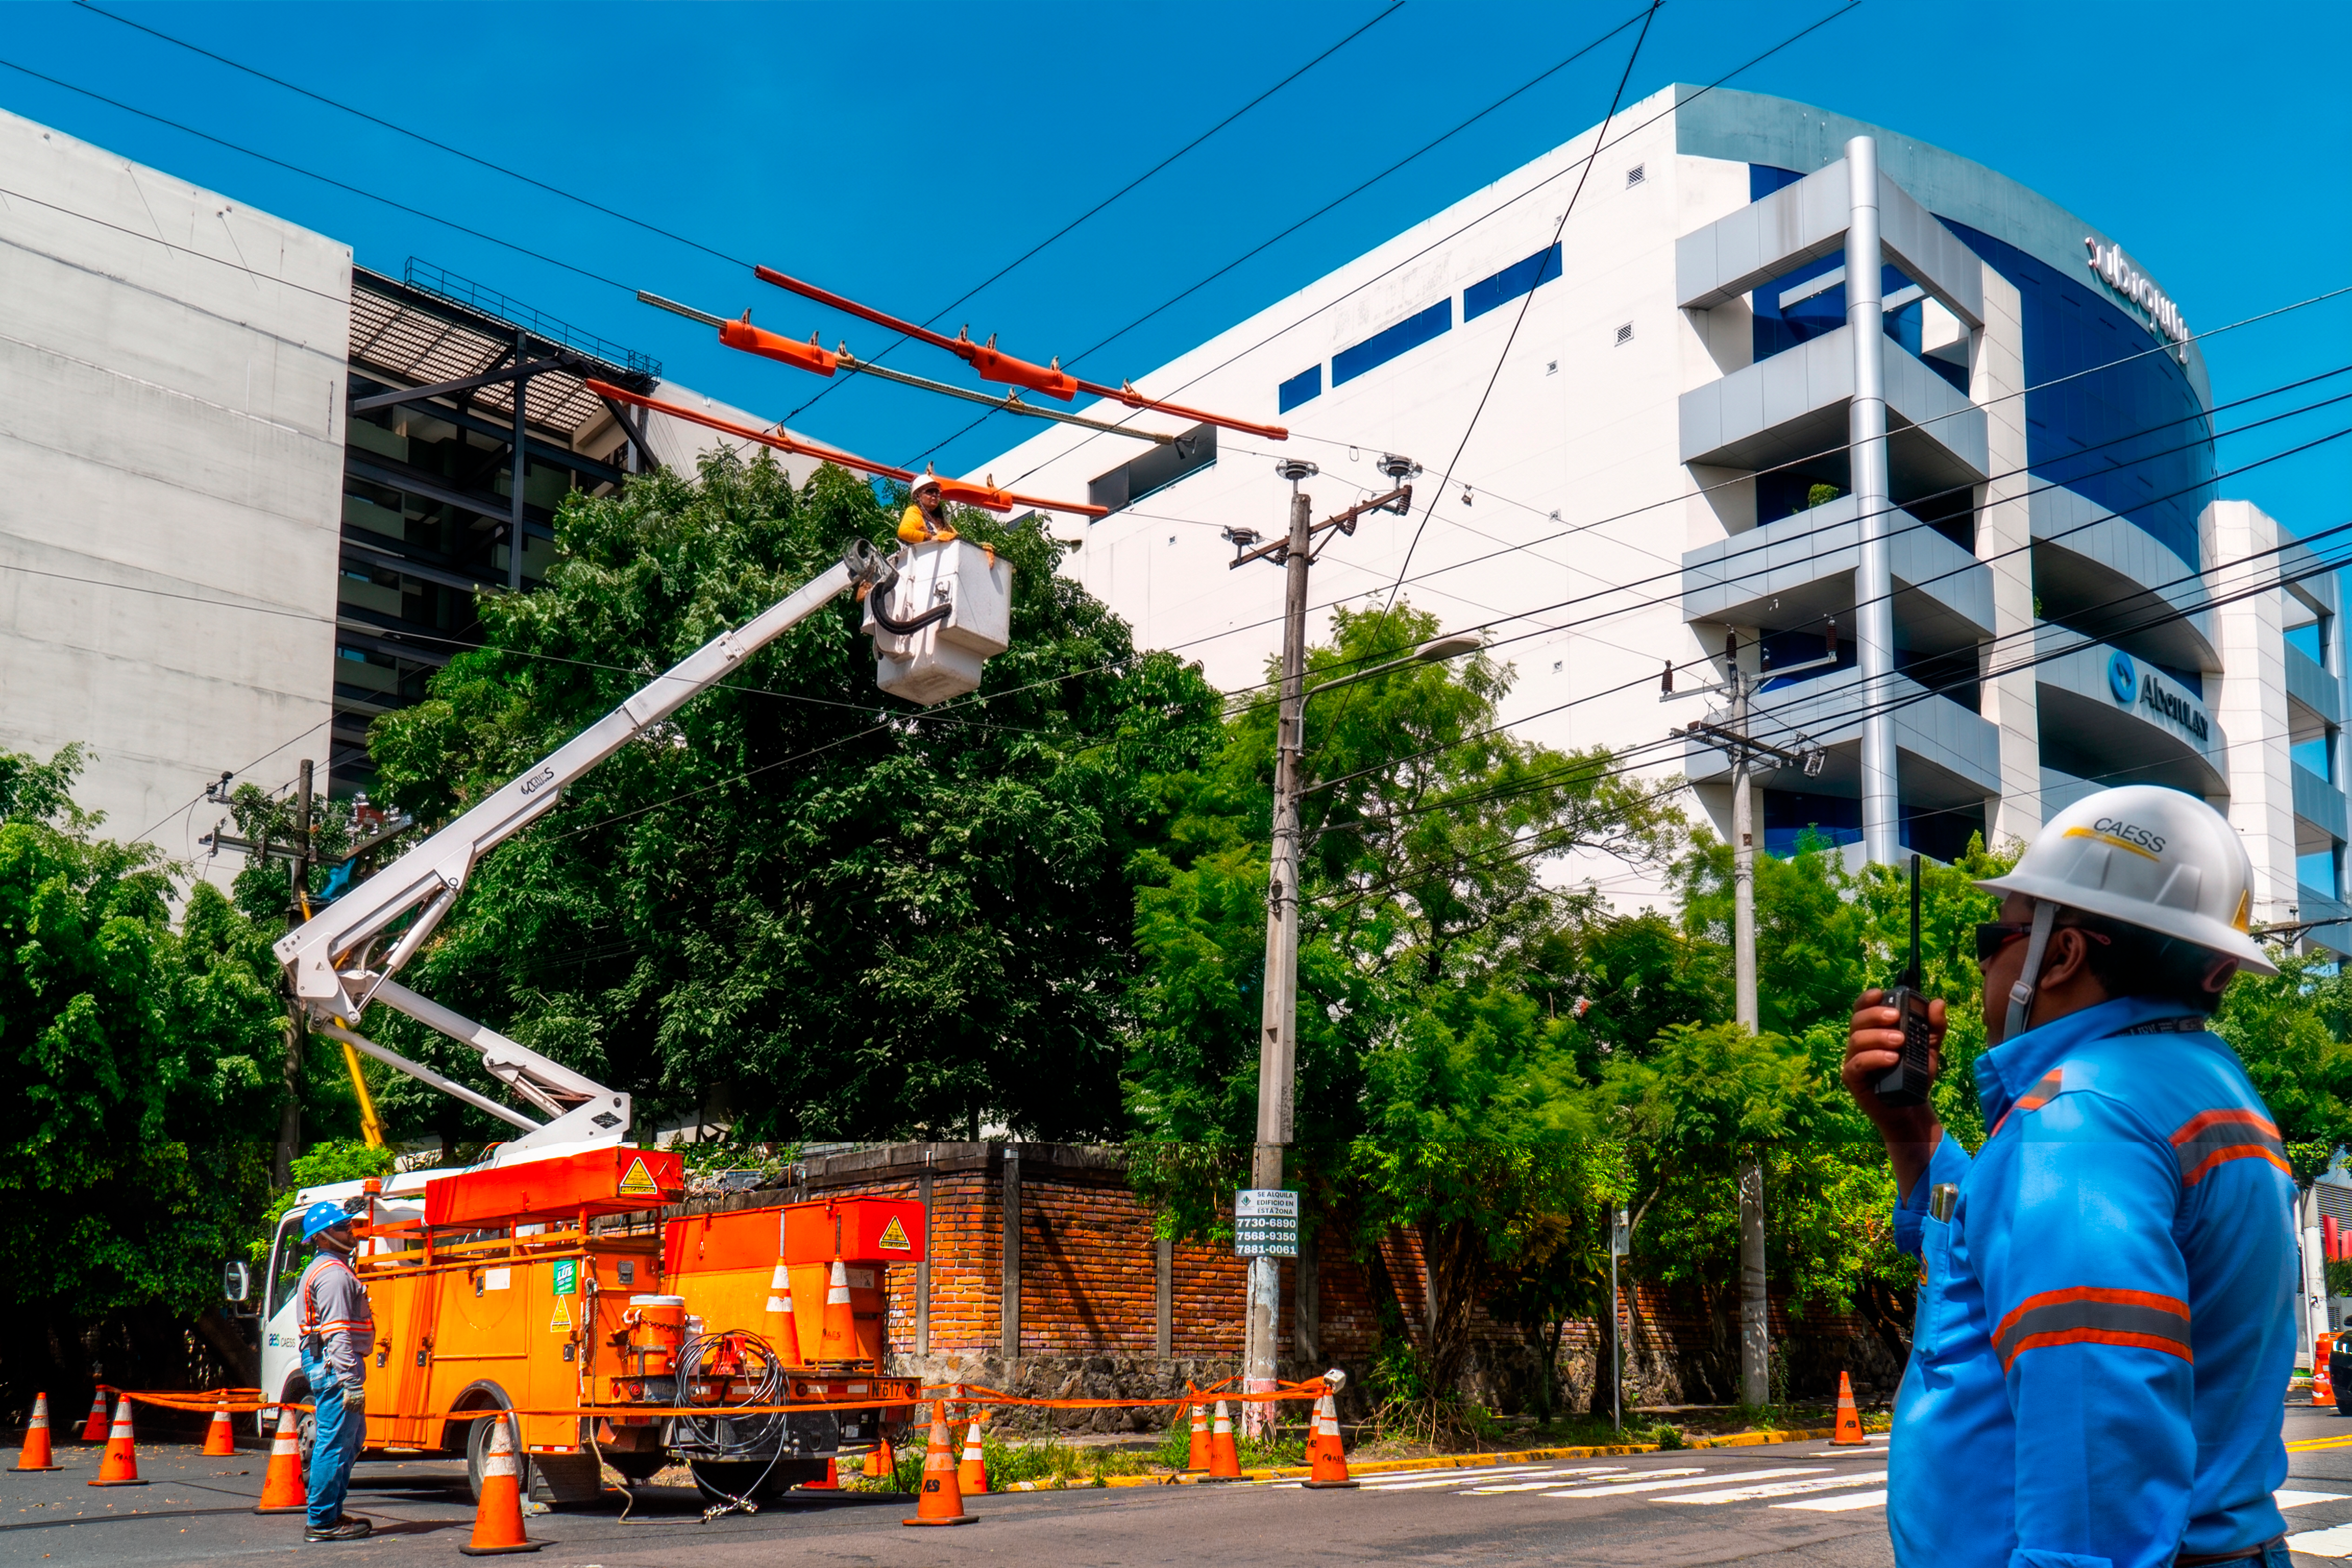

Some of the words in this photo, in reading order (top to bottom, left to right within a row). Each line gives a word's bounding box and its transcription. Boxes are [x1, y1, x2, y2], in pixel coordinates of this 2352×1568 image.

[2094, 818, 2166, 852] CAESS
[1237, 1218, 1296, 1228] 7730-6890
[1237, 1231, 1296, 1241] 7568-9350
[1237, 1244, 1296, 1255] 7881-0061
[269, 1333, 279, 1346] aes
[922, 1479, 941, 1493] AES
